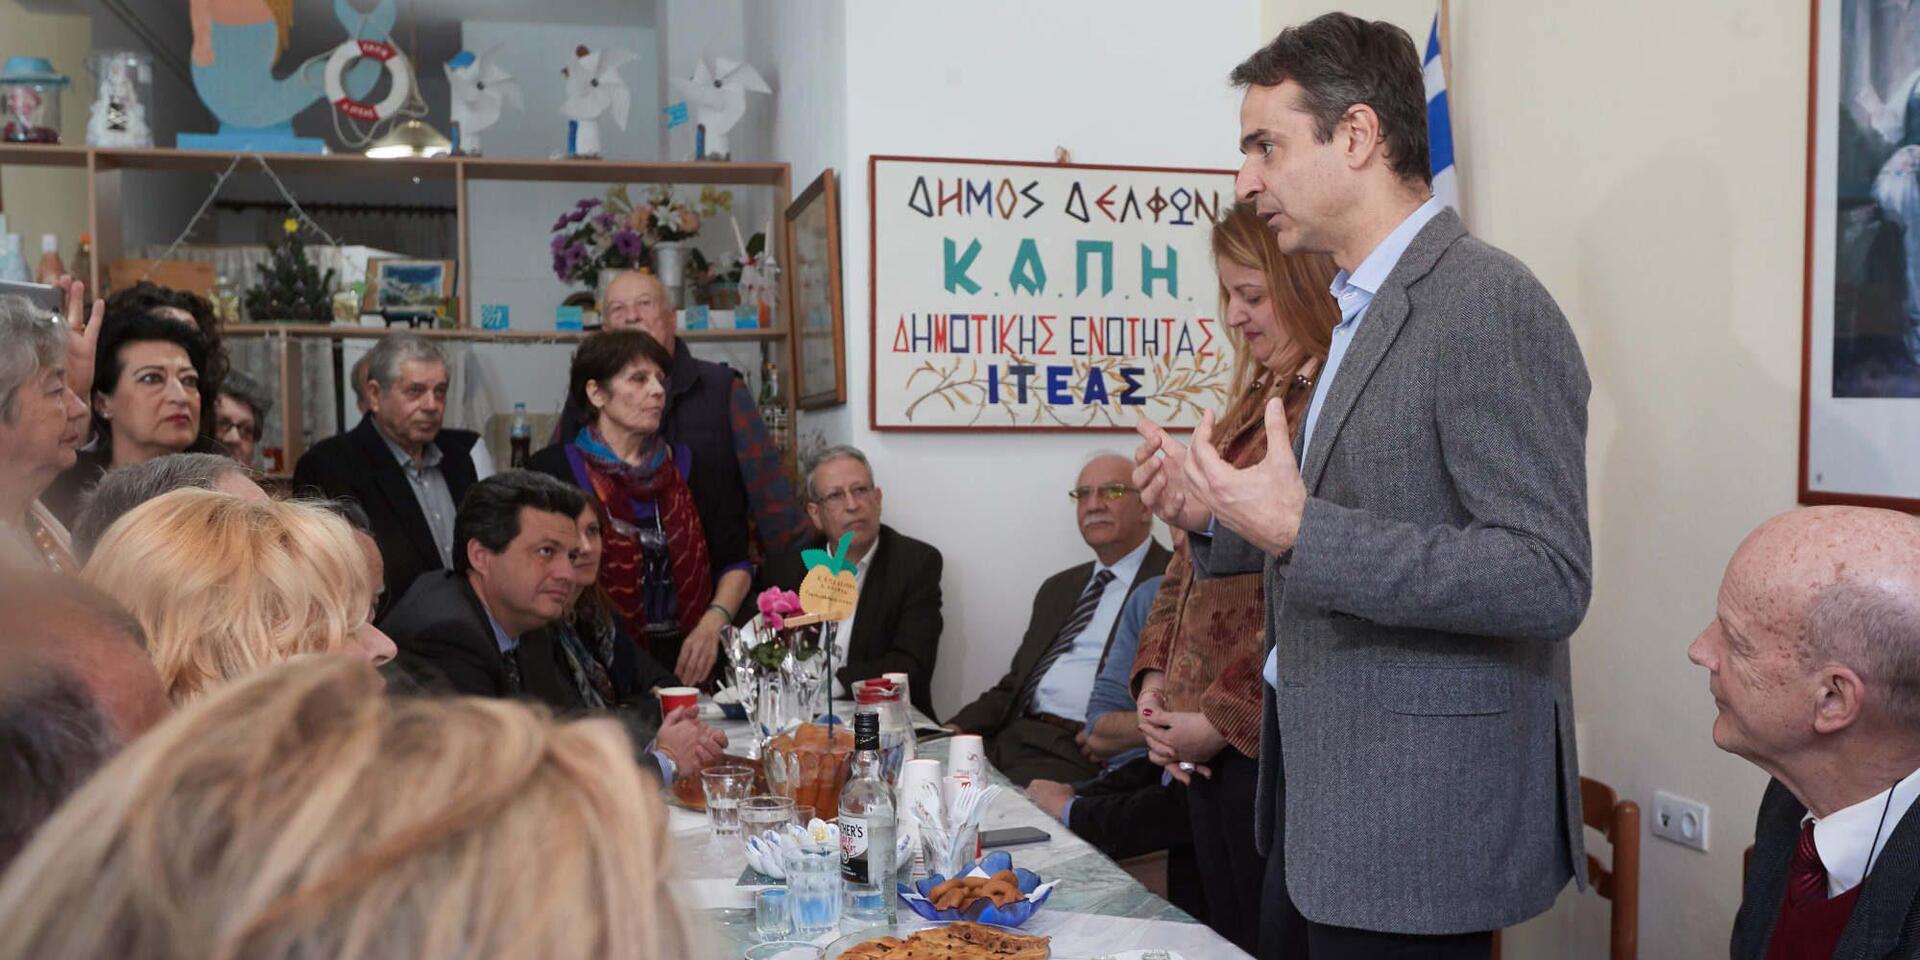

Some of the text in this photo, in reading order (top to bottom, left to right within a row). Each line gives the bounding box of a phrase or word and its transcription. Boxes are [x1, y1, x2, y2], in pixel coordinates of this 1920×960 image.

[1065, 181, 1221, 225] ΔΕΛΦΩΝ
[893, 313, 1215, 357] ΔΗΜΟΤΙΚΗΣ ΕΝΟΤΗΤΑΣ
[987, 364, 1147, 406] ΙΤΕΑΣ
